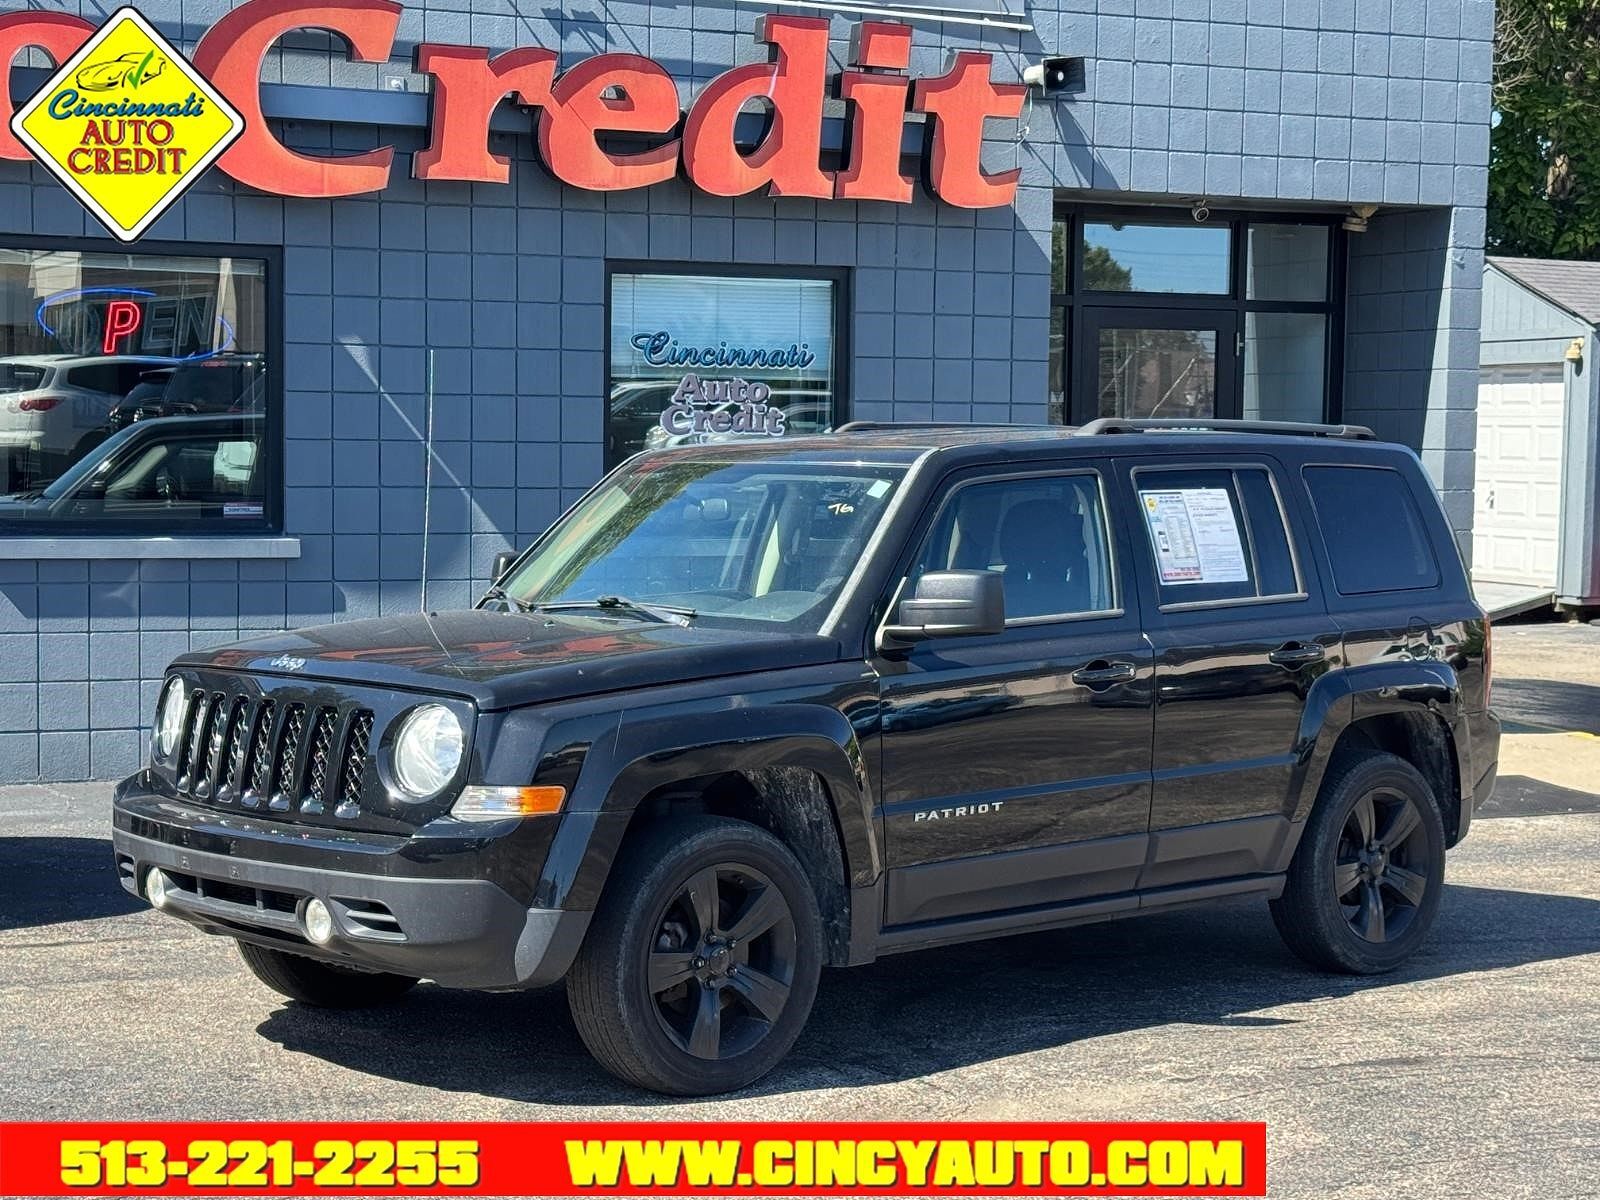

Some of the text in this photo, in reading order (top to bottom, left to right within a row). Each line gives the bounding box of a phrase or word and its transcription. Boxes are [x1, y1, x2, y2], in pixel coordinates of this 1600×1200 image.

[190, 0, 1028, 209] Credit
[60, 295, 215, 355] OPEN
[630, 330, 816, 369] Cincinnati
[671, 373, 771, 404] Auto
[660, 404, 786, 436] Credit
[270, 654, 307, 672] Jeep
[914, 802, 1004, 822] PATRIOT
